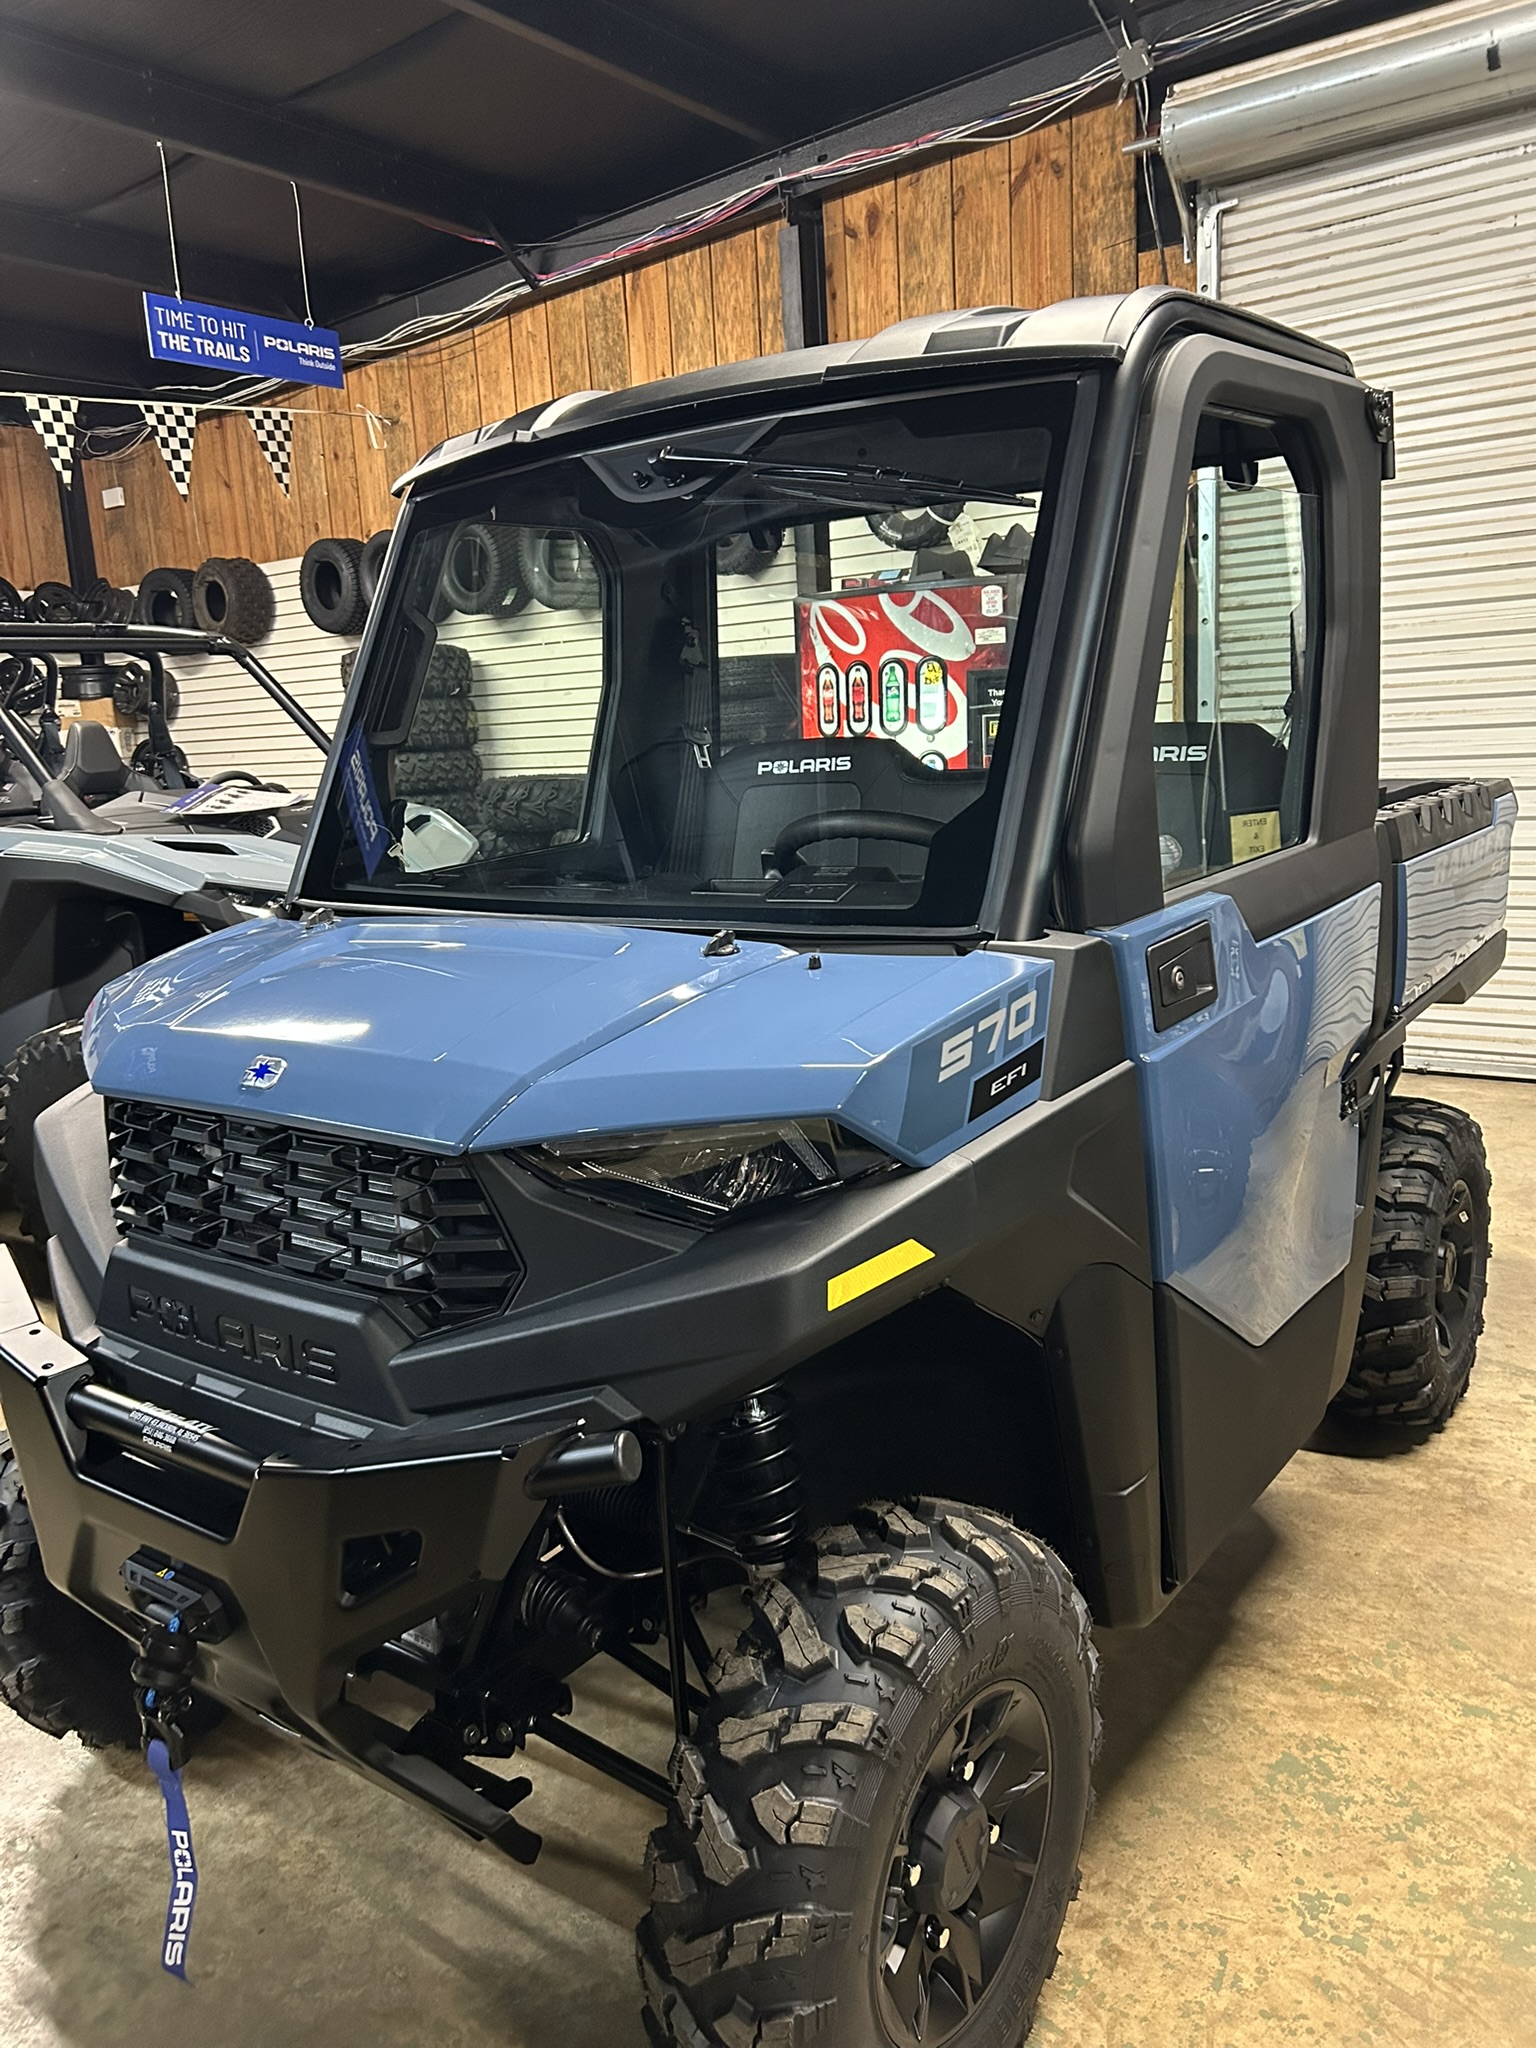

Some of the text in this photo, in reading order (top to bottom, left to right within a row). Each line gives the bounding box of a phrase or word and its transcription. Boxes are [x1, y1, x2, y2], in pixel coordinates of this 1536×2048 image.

[154, 306, 247, 340] TIME TO HIT
[157, 331, 250, 363] THE TRAILS
[263, 335, 335, 359] POLARIS
[298, 356, 336, 371] Think Outside
[757, 756, 852, 775] POLARIS
[1432, 826, 1507, 888] RANGER
[938, 989, 1037, 1083] 570
[990, 1062, 1027, 1096] EFI
[128, 1283, 340, 1385] POLARIS
[163, 1829, 194, 1966] POLARIS
